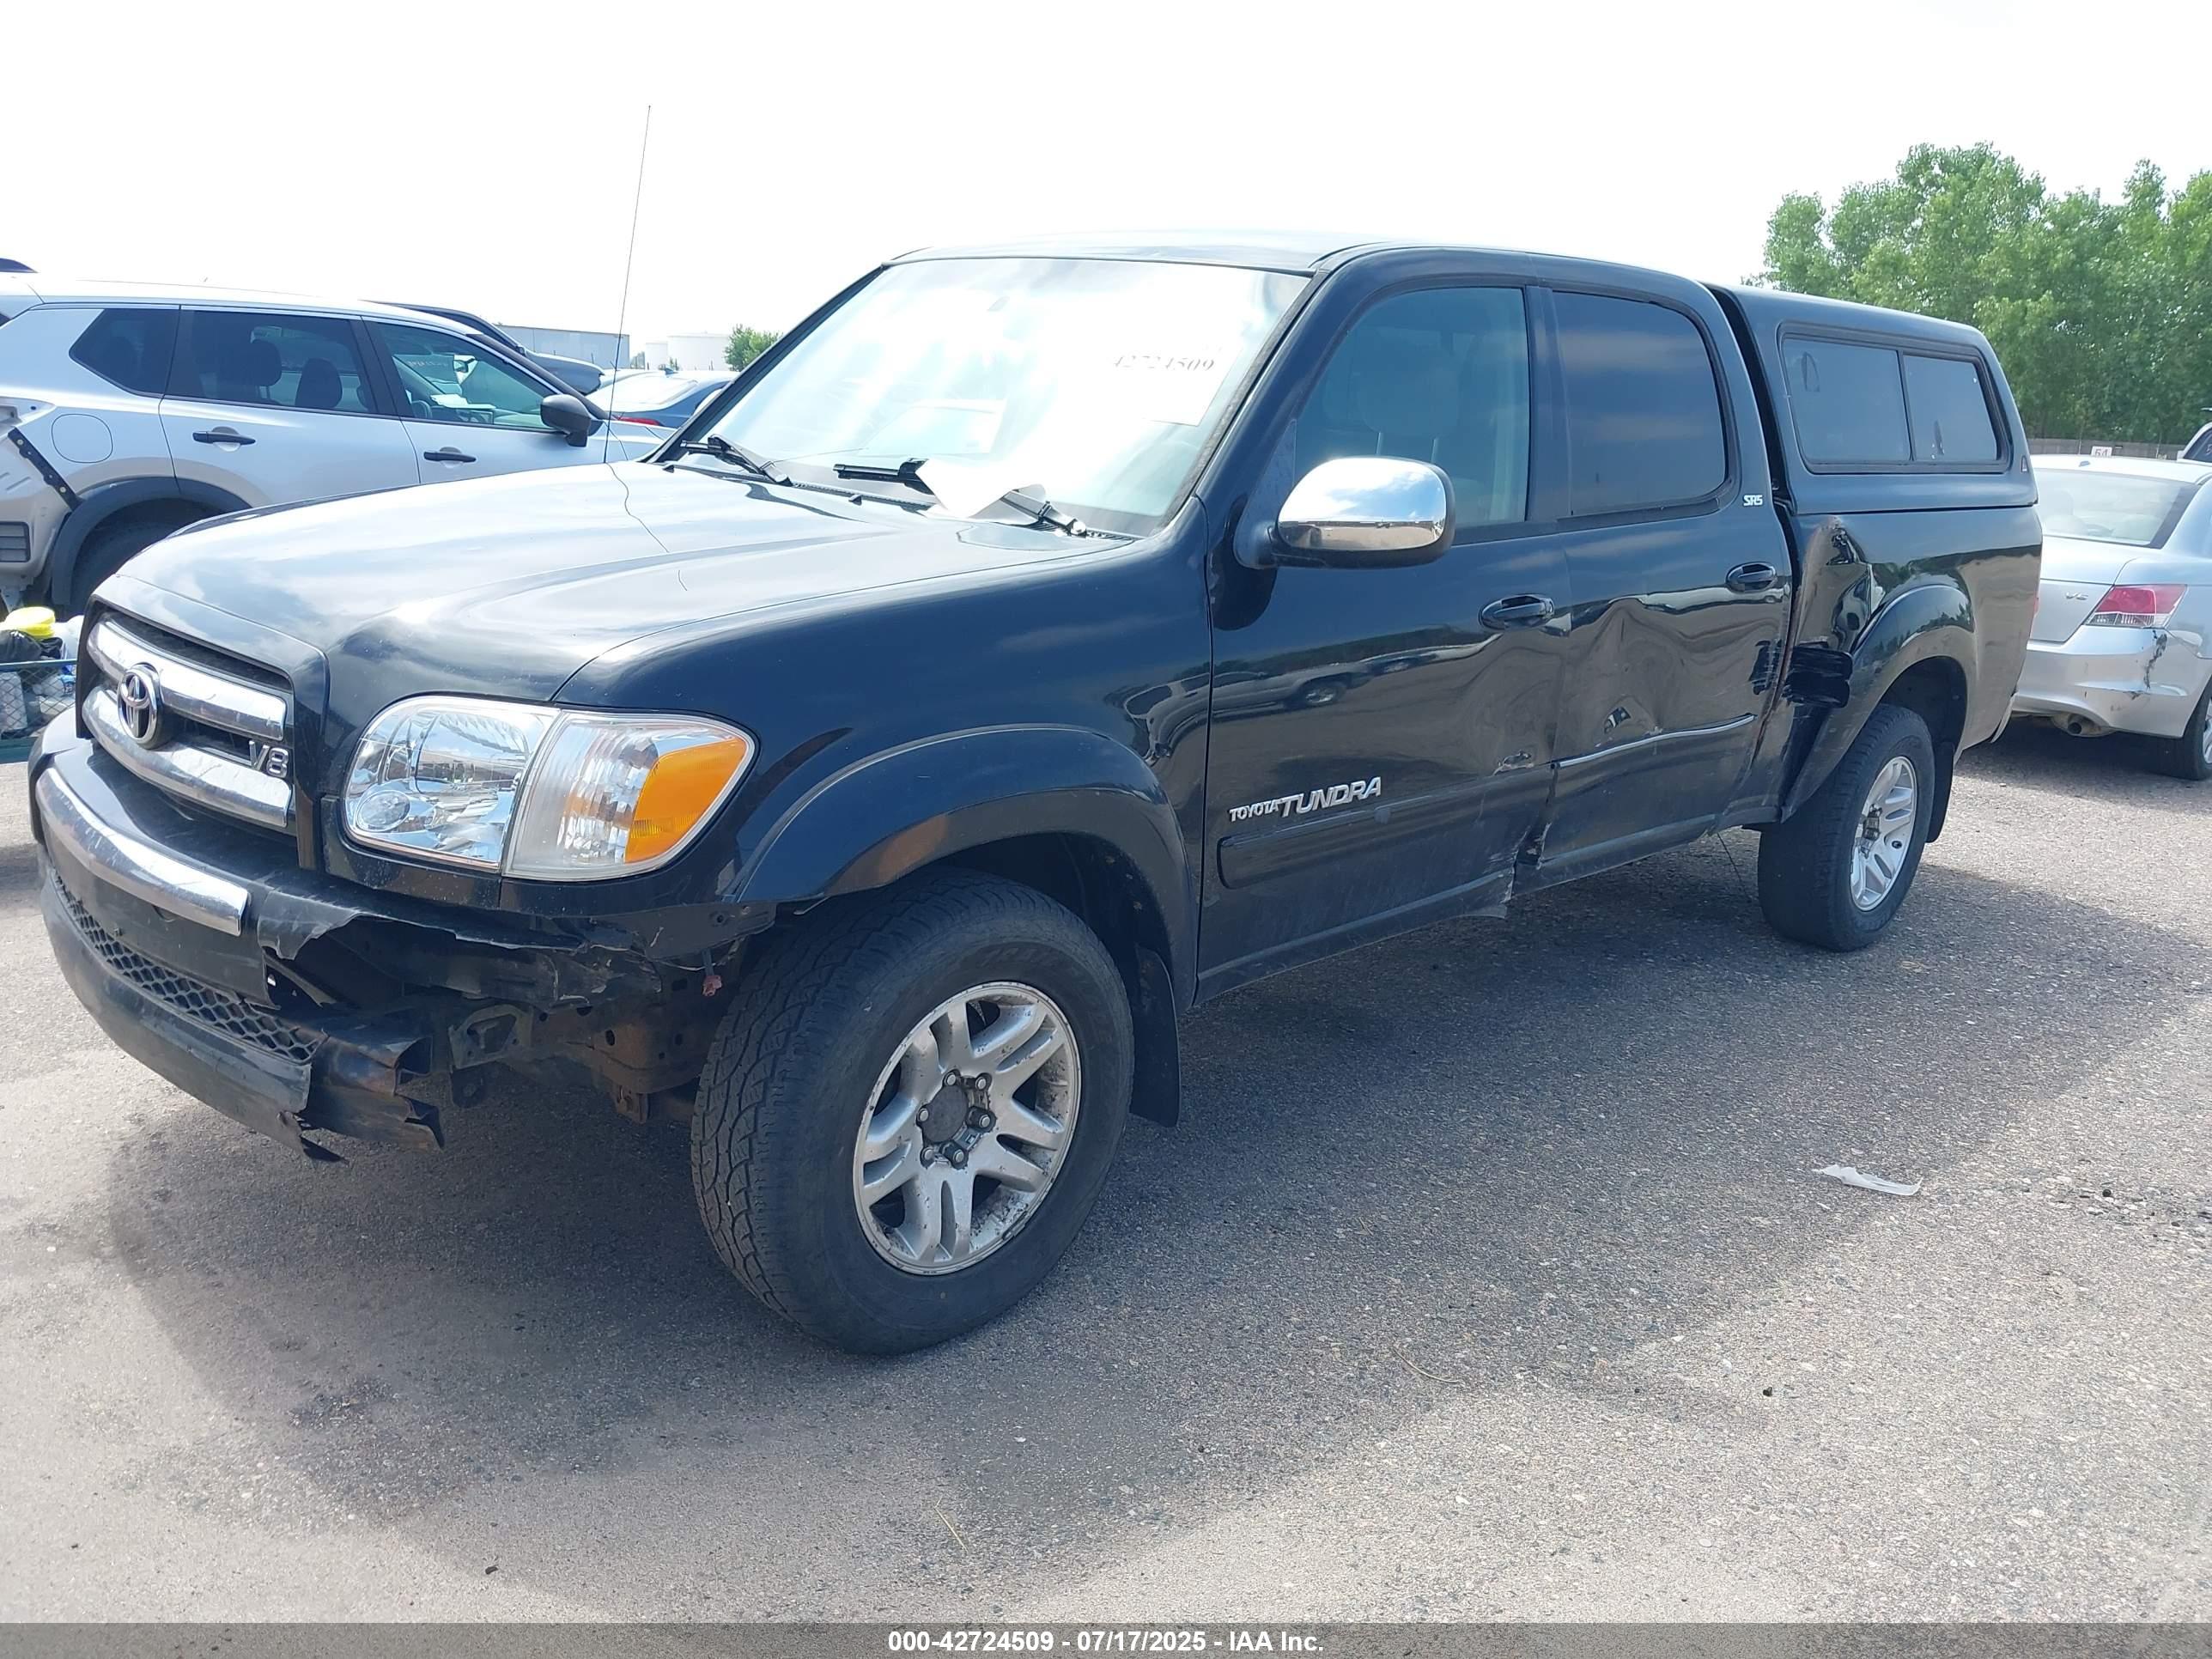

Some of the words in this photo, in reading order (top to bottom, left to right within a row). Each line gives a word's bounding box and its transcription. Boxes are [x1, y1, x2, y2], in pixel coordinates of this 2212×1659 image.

[1743, 495, 1763, 507] SR5
[248, 739, 289, 779] V8
[1229, 798, 1280, 823] TOYOTA
[1280, 776, 1382, 818] TUNDRA
